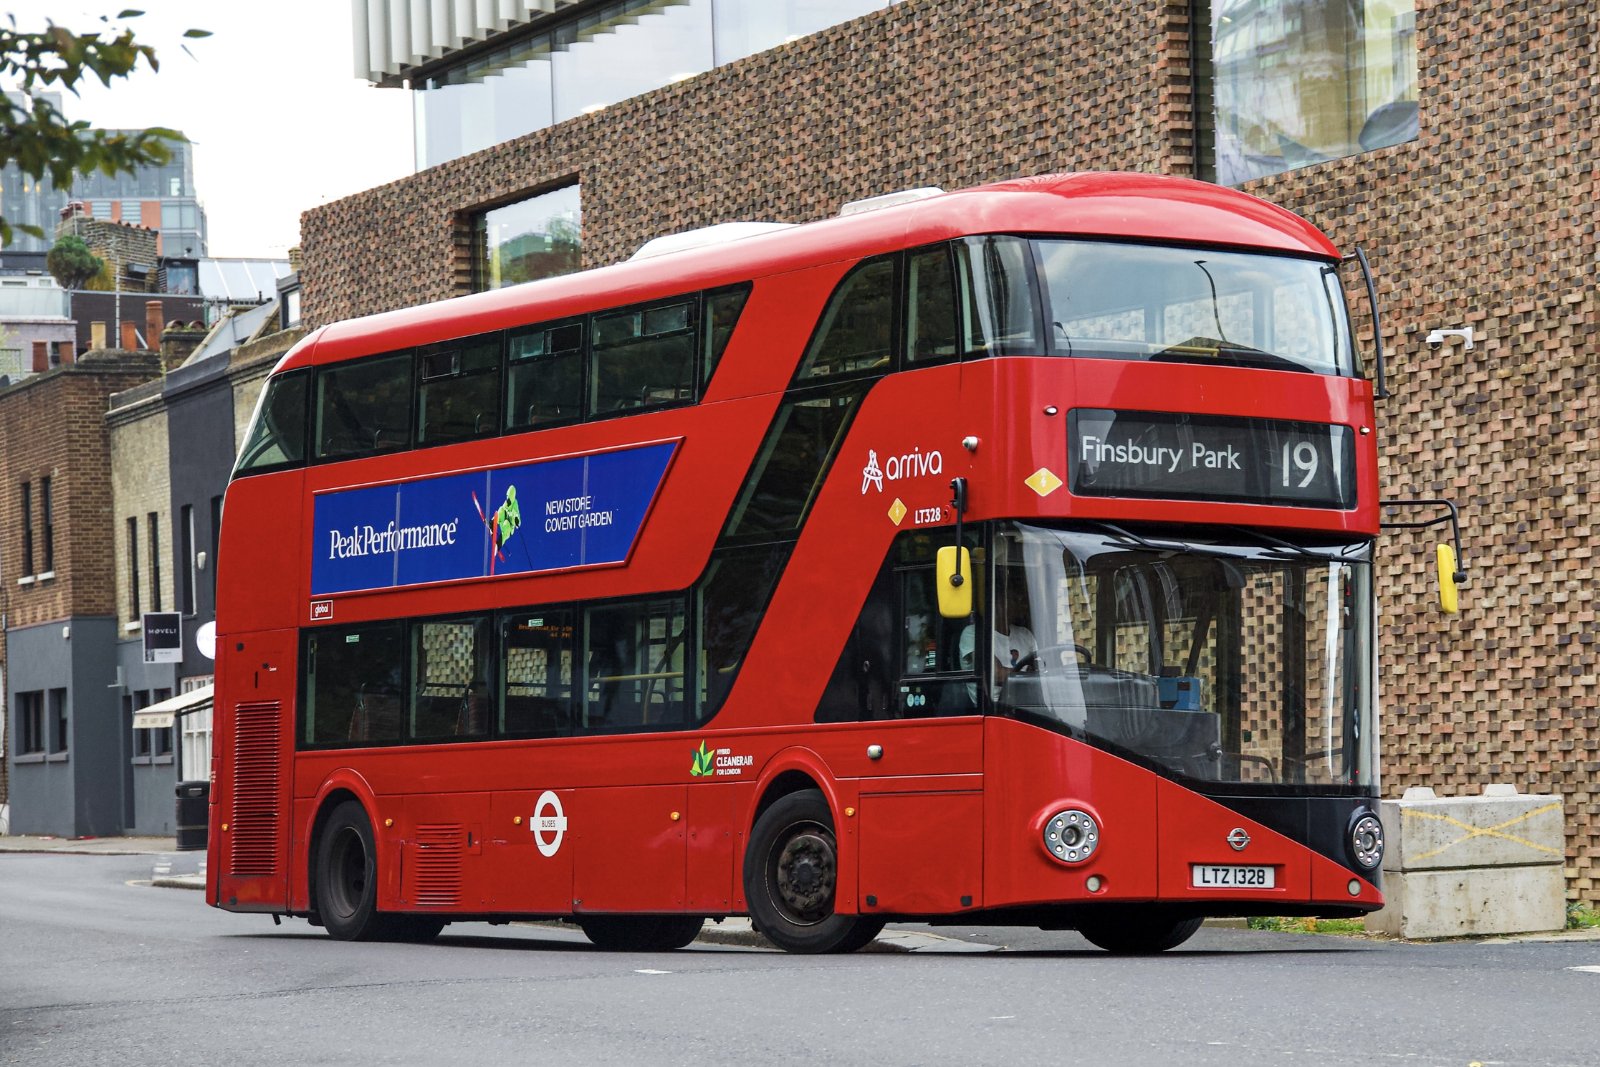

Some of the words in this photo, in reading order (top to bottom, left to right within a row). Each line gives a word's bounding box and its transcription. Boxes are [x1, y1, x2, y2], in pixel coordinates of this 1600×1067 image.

[886, 447, 943, 480] arriva
[1081, 436, 1183, 473] Finsbury
[1192, 442, 1241, 470] Park
[1282, 441, 1318, 488] 19
[545, 499, 565, 515] NEW
[565, 496, 591, 513] STORE
[545, 515, 578, 533] COVENT
[578, 510, 613, 528] GARDEN
[915, 507, 941, 524] LT328
[315, 603, 329, 617] global
[724, 768, 741, 776] LONDON
[542, 819, 556, 828] BUSES
[1202, 868, 1230, 884] LTZ
[1234, 869, 1265, 885] 1328
